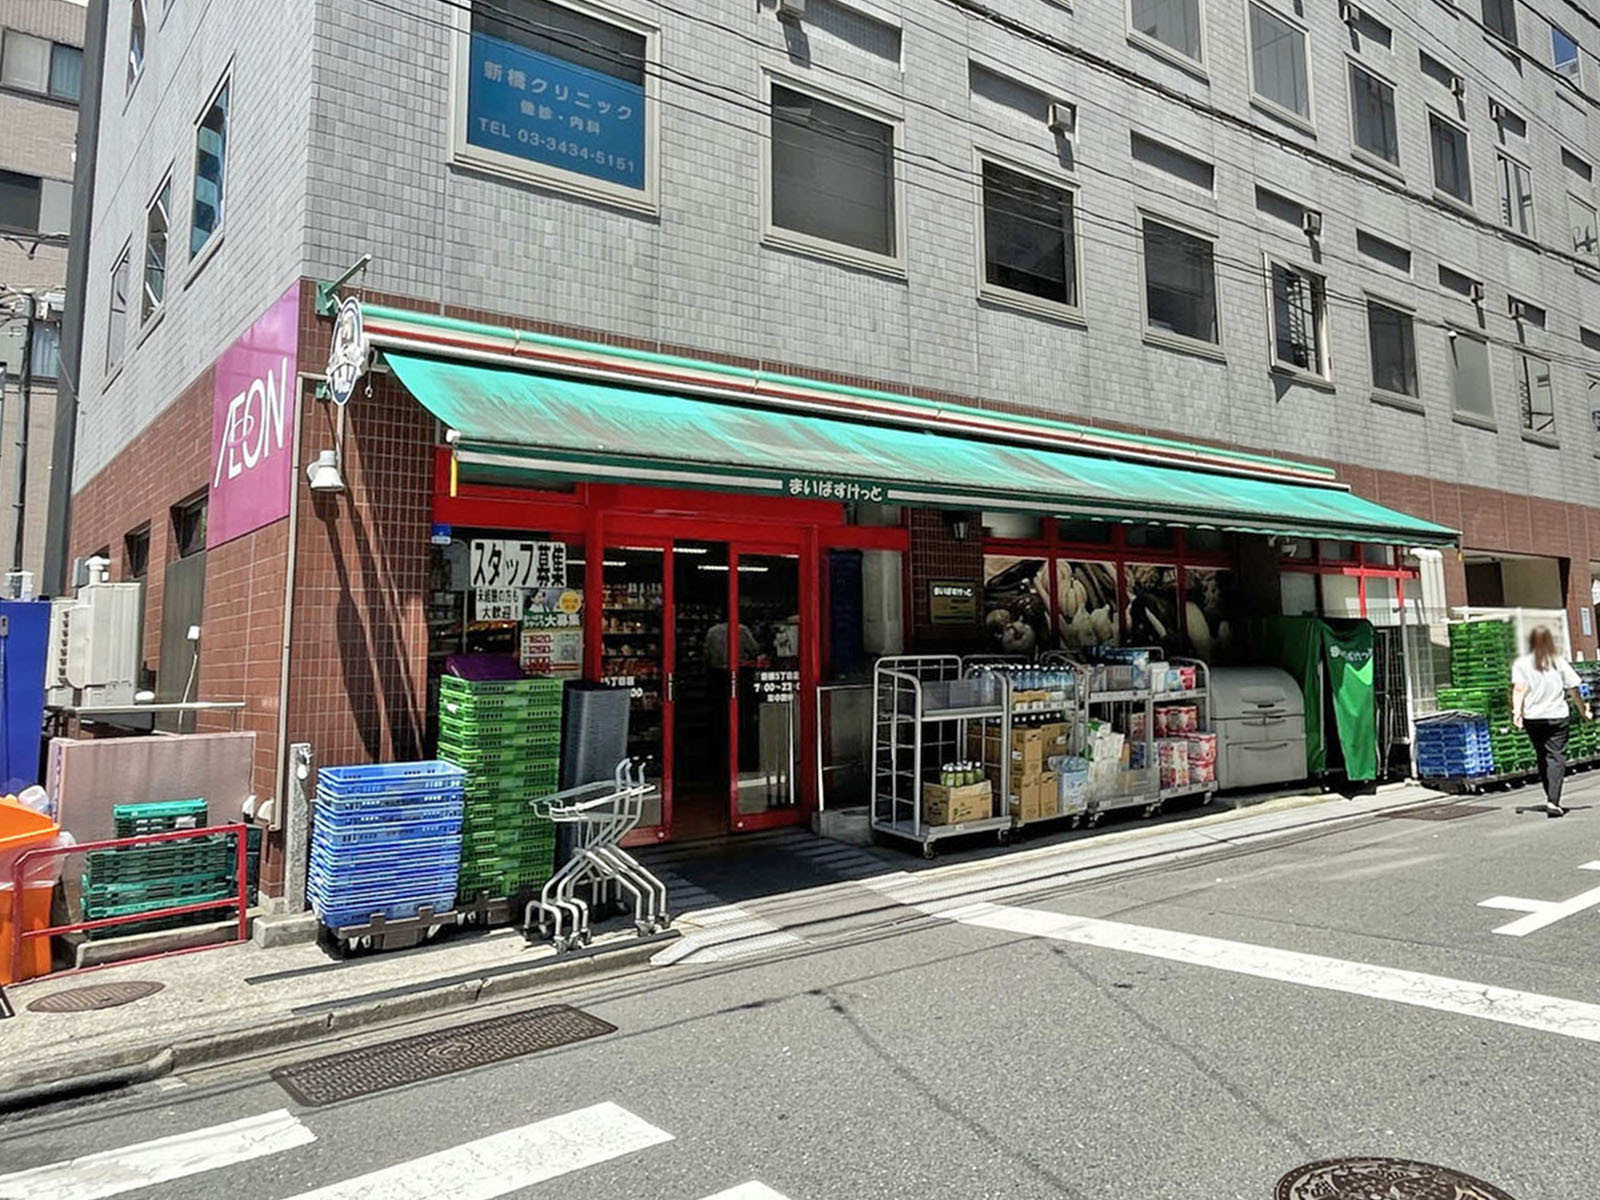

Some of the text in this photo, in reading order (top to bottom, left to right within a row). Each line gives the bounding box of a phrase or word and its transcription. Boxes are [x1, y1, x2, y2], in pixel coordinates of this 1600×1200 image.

[483, 60, 633, 120] 新橋クリニック
[477, 116, 511, 139] TEL
[519, 99, 600, 135] 健診・内科
[788, 478, 883, 502] まいばすけっと
[472, 541, 565, 587] スタッフ募集
